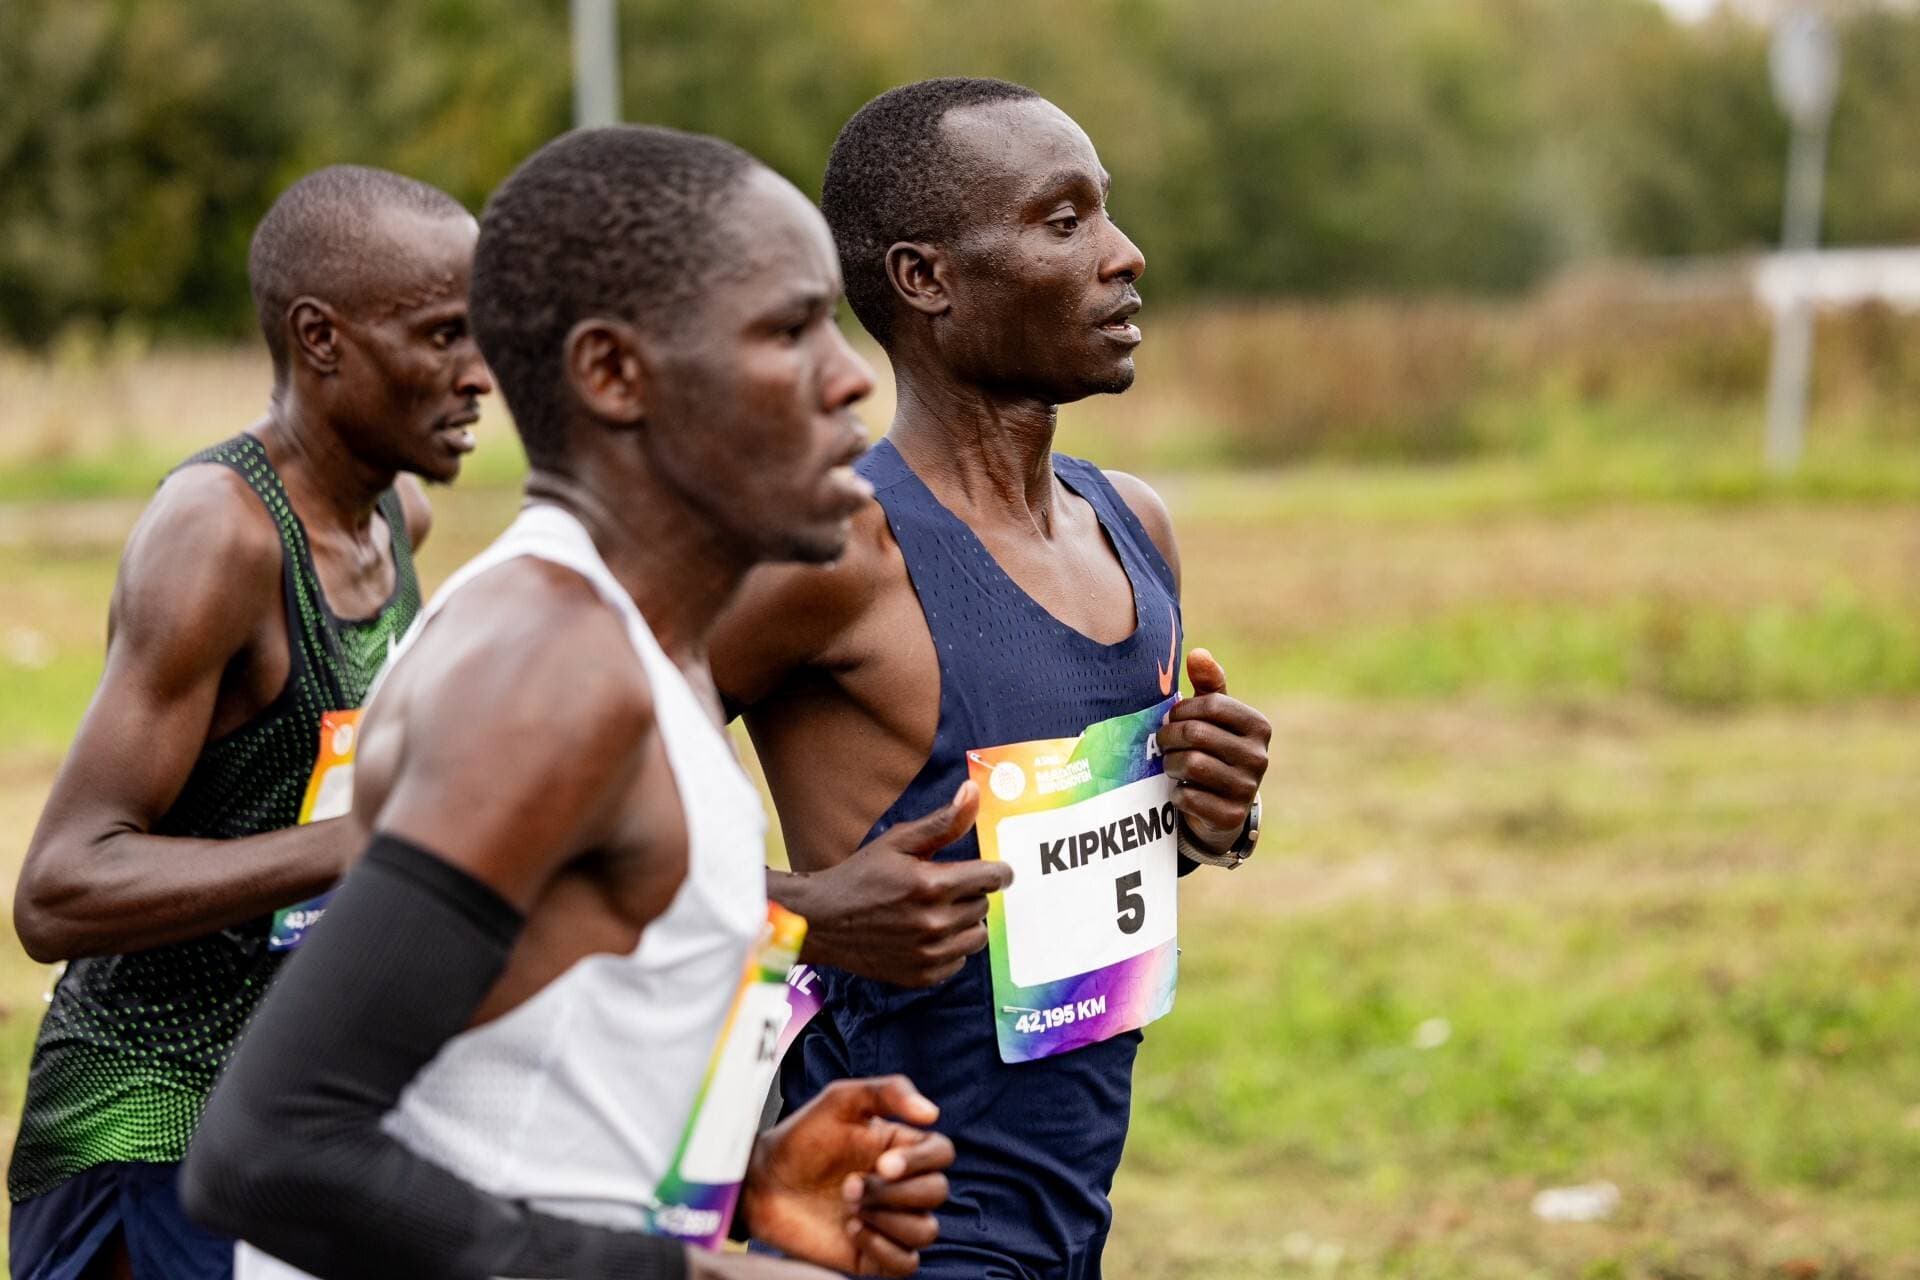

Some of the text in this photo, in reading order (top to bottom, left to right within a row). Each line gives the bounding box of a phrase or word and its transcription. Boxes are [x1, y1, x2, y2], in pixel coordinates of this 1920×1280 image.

[1039, 801, 1177, 875] KIPKEMO
[1115, 870, 1146, 935] 5
[1015, 995, 1107, 1034] 42,195 KM
